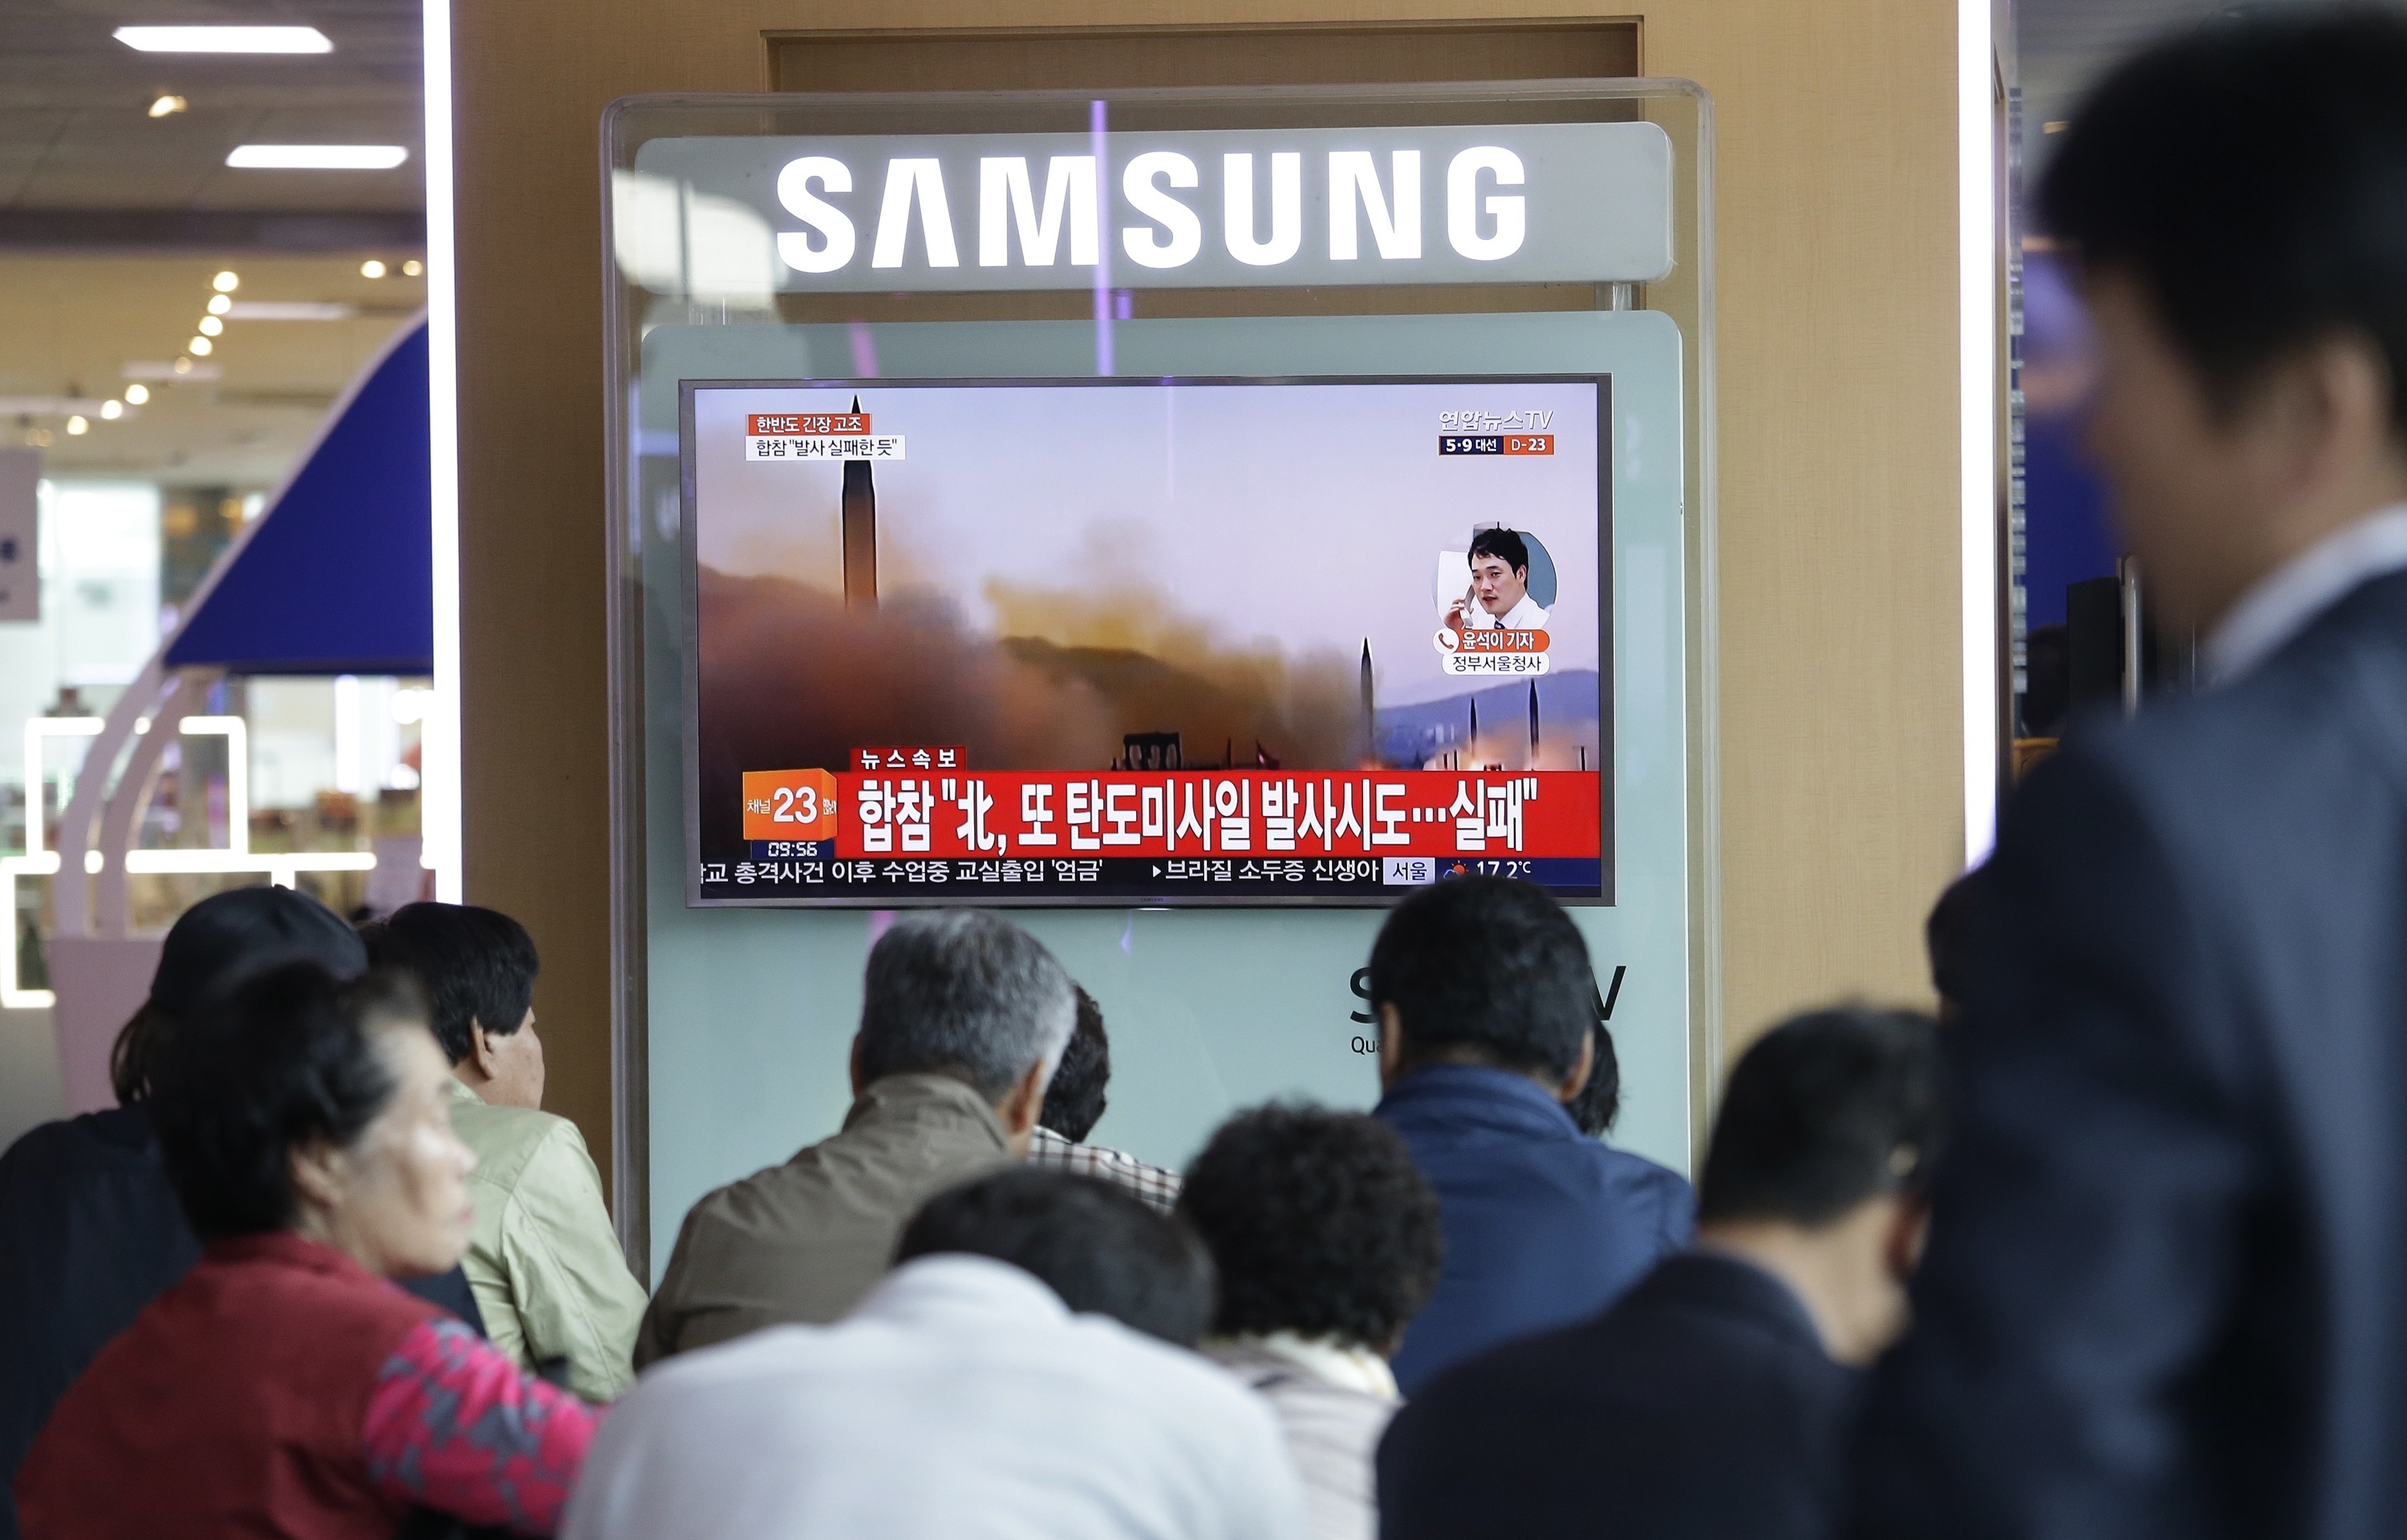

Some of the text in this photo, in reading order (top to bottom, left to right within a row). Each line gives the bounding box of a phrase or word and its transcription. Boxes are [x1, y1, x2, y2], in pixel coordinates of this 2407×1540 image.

[776, 146, 1526, 274] SAMSUNG
[756, 415, 863, 433] 한반도 긴장 고조
[1439, 410, 1554, 432] 연합뉴스TV
[757, 439, 897, 456] 합참 "발사 실패한 듯"
[1475, 439, 1497, 452] 대선
[1511, 438, 1546, 452] D-23
[1462, 631, 1535, 650] 윤석이 기자
[1452, 655, 1541, 671] 정부서울청사
[747, 798, 771, 814] 채널
[773, 786, 818, 824] 23
[858, 779, 935, 852] 합참
[941, 778, 1007, 857] "北,
[1017, 783, 1057, 845] 또
[1066, 779, 1252, 852] 탄도미사일
[768, 841, 818, 857] 09:56
[734, 861, 824, 884] 총격사건
[832, 861, 876, 883] 이후
[882, 861, 949, 883] 수업중
[956, 860, 1044, 882] 교실출입
[1051, 858, 1102, 882] '엄금'
[1165, 860, 1379, 882] 브라질 소두증 신생아
[1392, 861, 1427, 881] 서울
